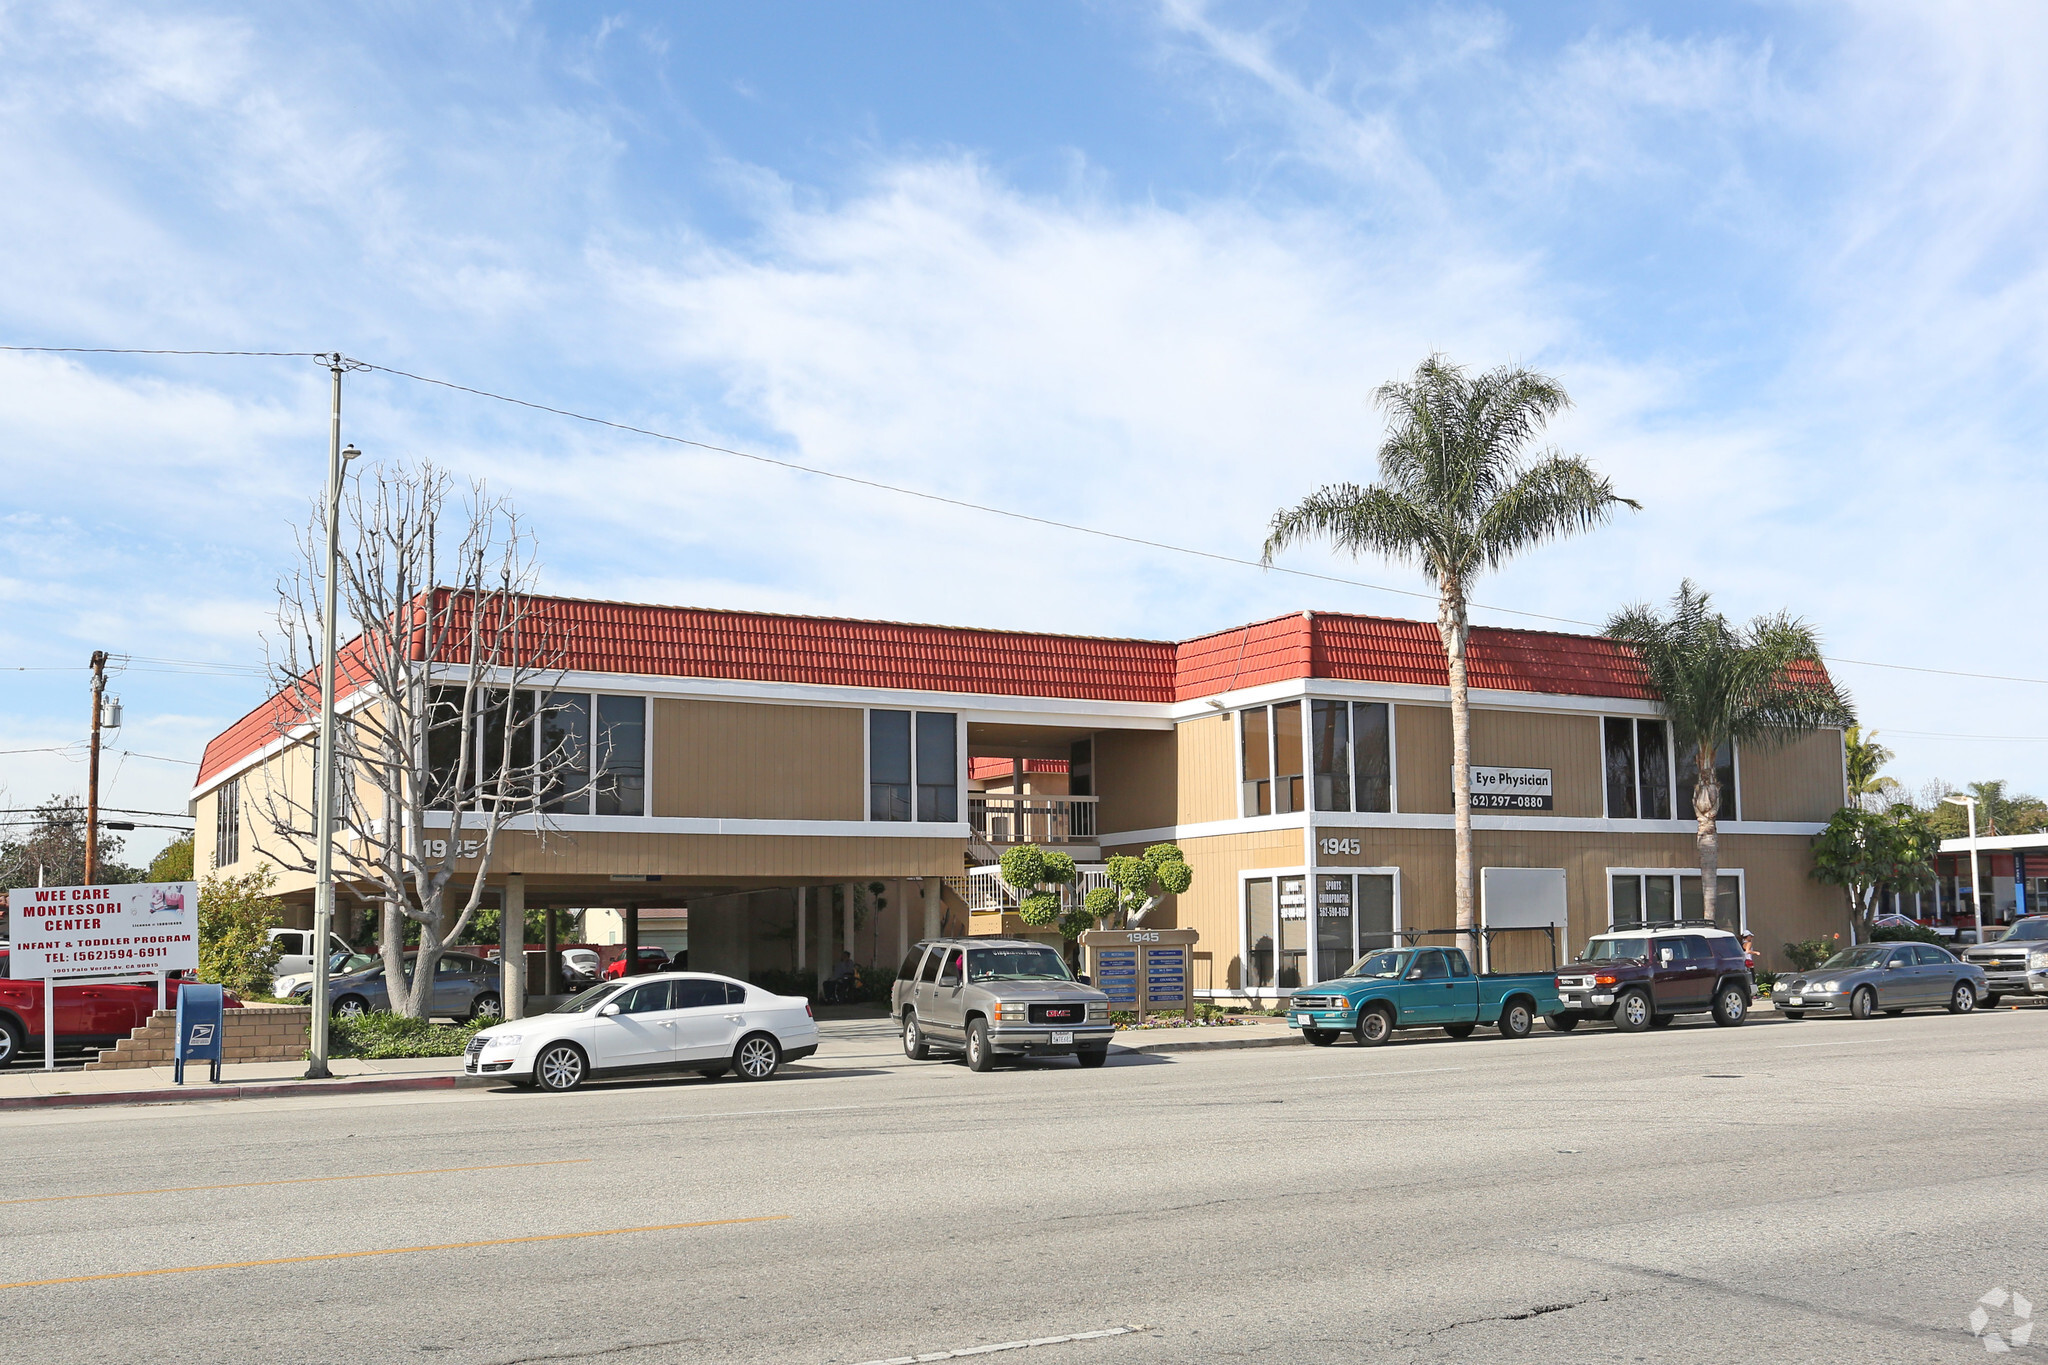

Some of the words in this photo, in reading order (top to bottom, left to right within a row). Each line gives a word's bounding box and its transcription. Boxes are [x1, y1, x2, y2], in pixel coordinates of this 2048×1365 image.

[1476, 772, 1496, 786] Eye
[1499, 773, 1548, 788] Physician
[1319, 838, 1360, 855] 1945
[1325, 881, 1342, 891] SPORTS
[35, 890, 67, 902] WEE
[72, 888, 109, 901] CARE
[1319, 893, 1349, 904] CHIROPRACTIC
[23, 903, 121, 917] MONTESSORI
[45, 918, 101, 931] CENTER
[17, 941, 60, 951] INFANT
[77, 937, 130, 948] TODDLER
[133, 934, 191, 945] PROGRAM
[1127, 932, 1159, 943] 1945
[45, 952, 69, 963] TEL:
[73, 947, 167, 962] (562)594-6911
[1046, 1010, 1070, 1018] GMC
